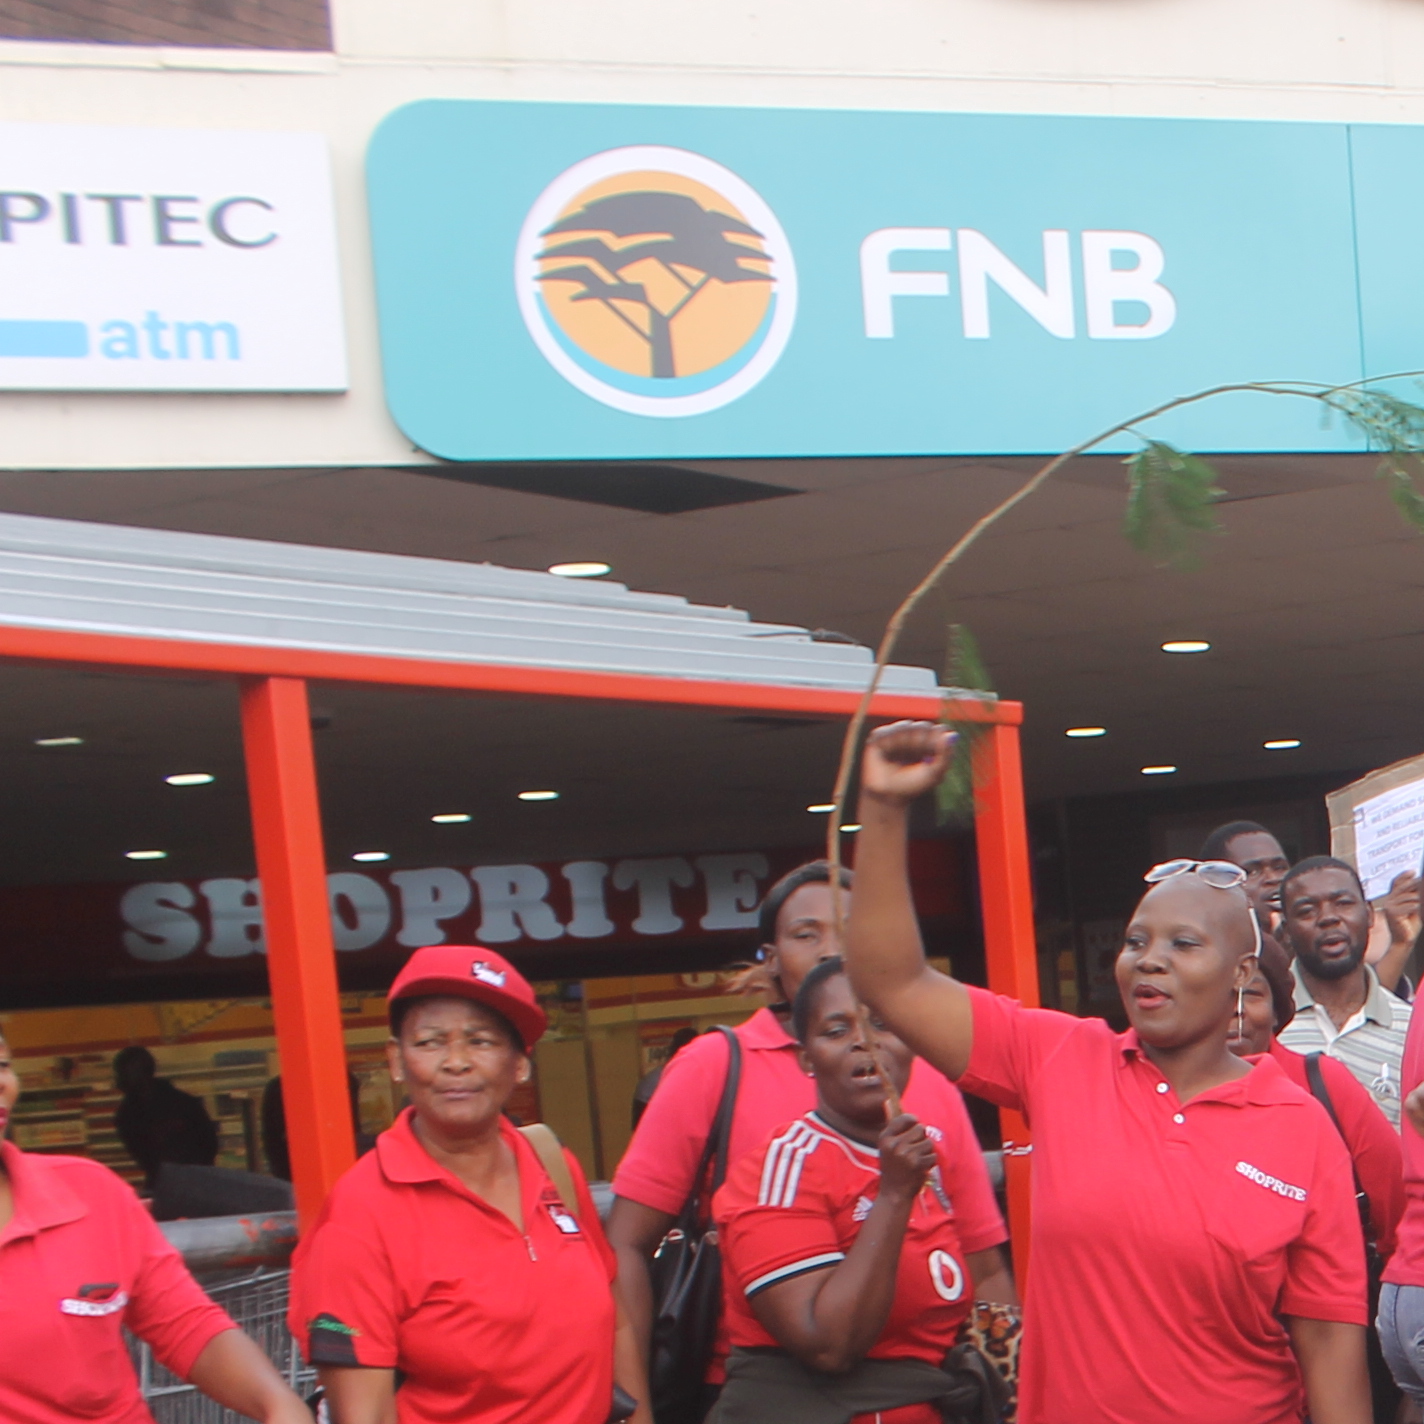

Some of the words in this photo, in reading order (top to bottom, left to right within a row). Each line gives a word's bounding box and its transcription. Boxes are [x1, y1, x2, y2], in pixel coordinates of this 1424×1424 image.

[0, 190, 279, 250] PITEC
[860, 227, 1177, 340] FNB
[99, 310, 241, 360] atm
[120, 852, 772, 962] SHOPRITE
[1235, 1161, 1307, 1201] SHOPRITE
